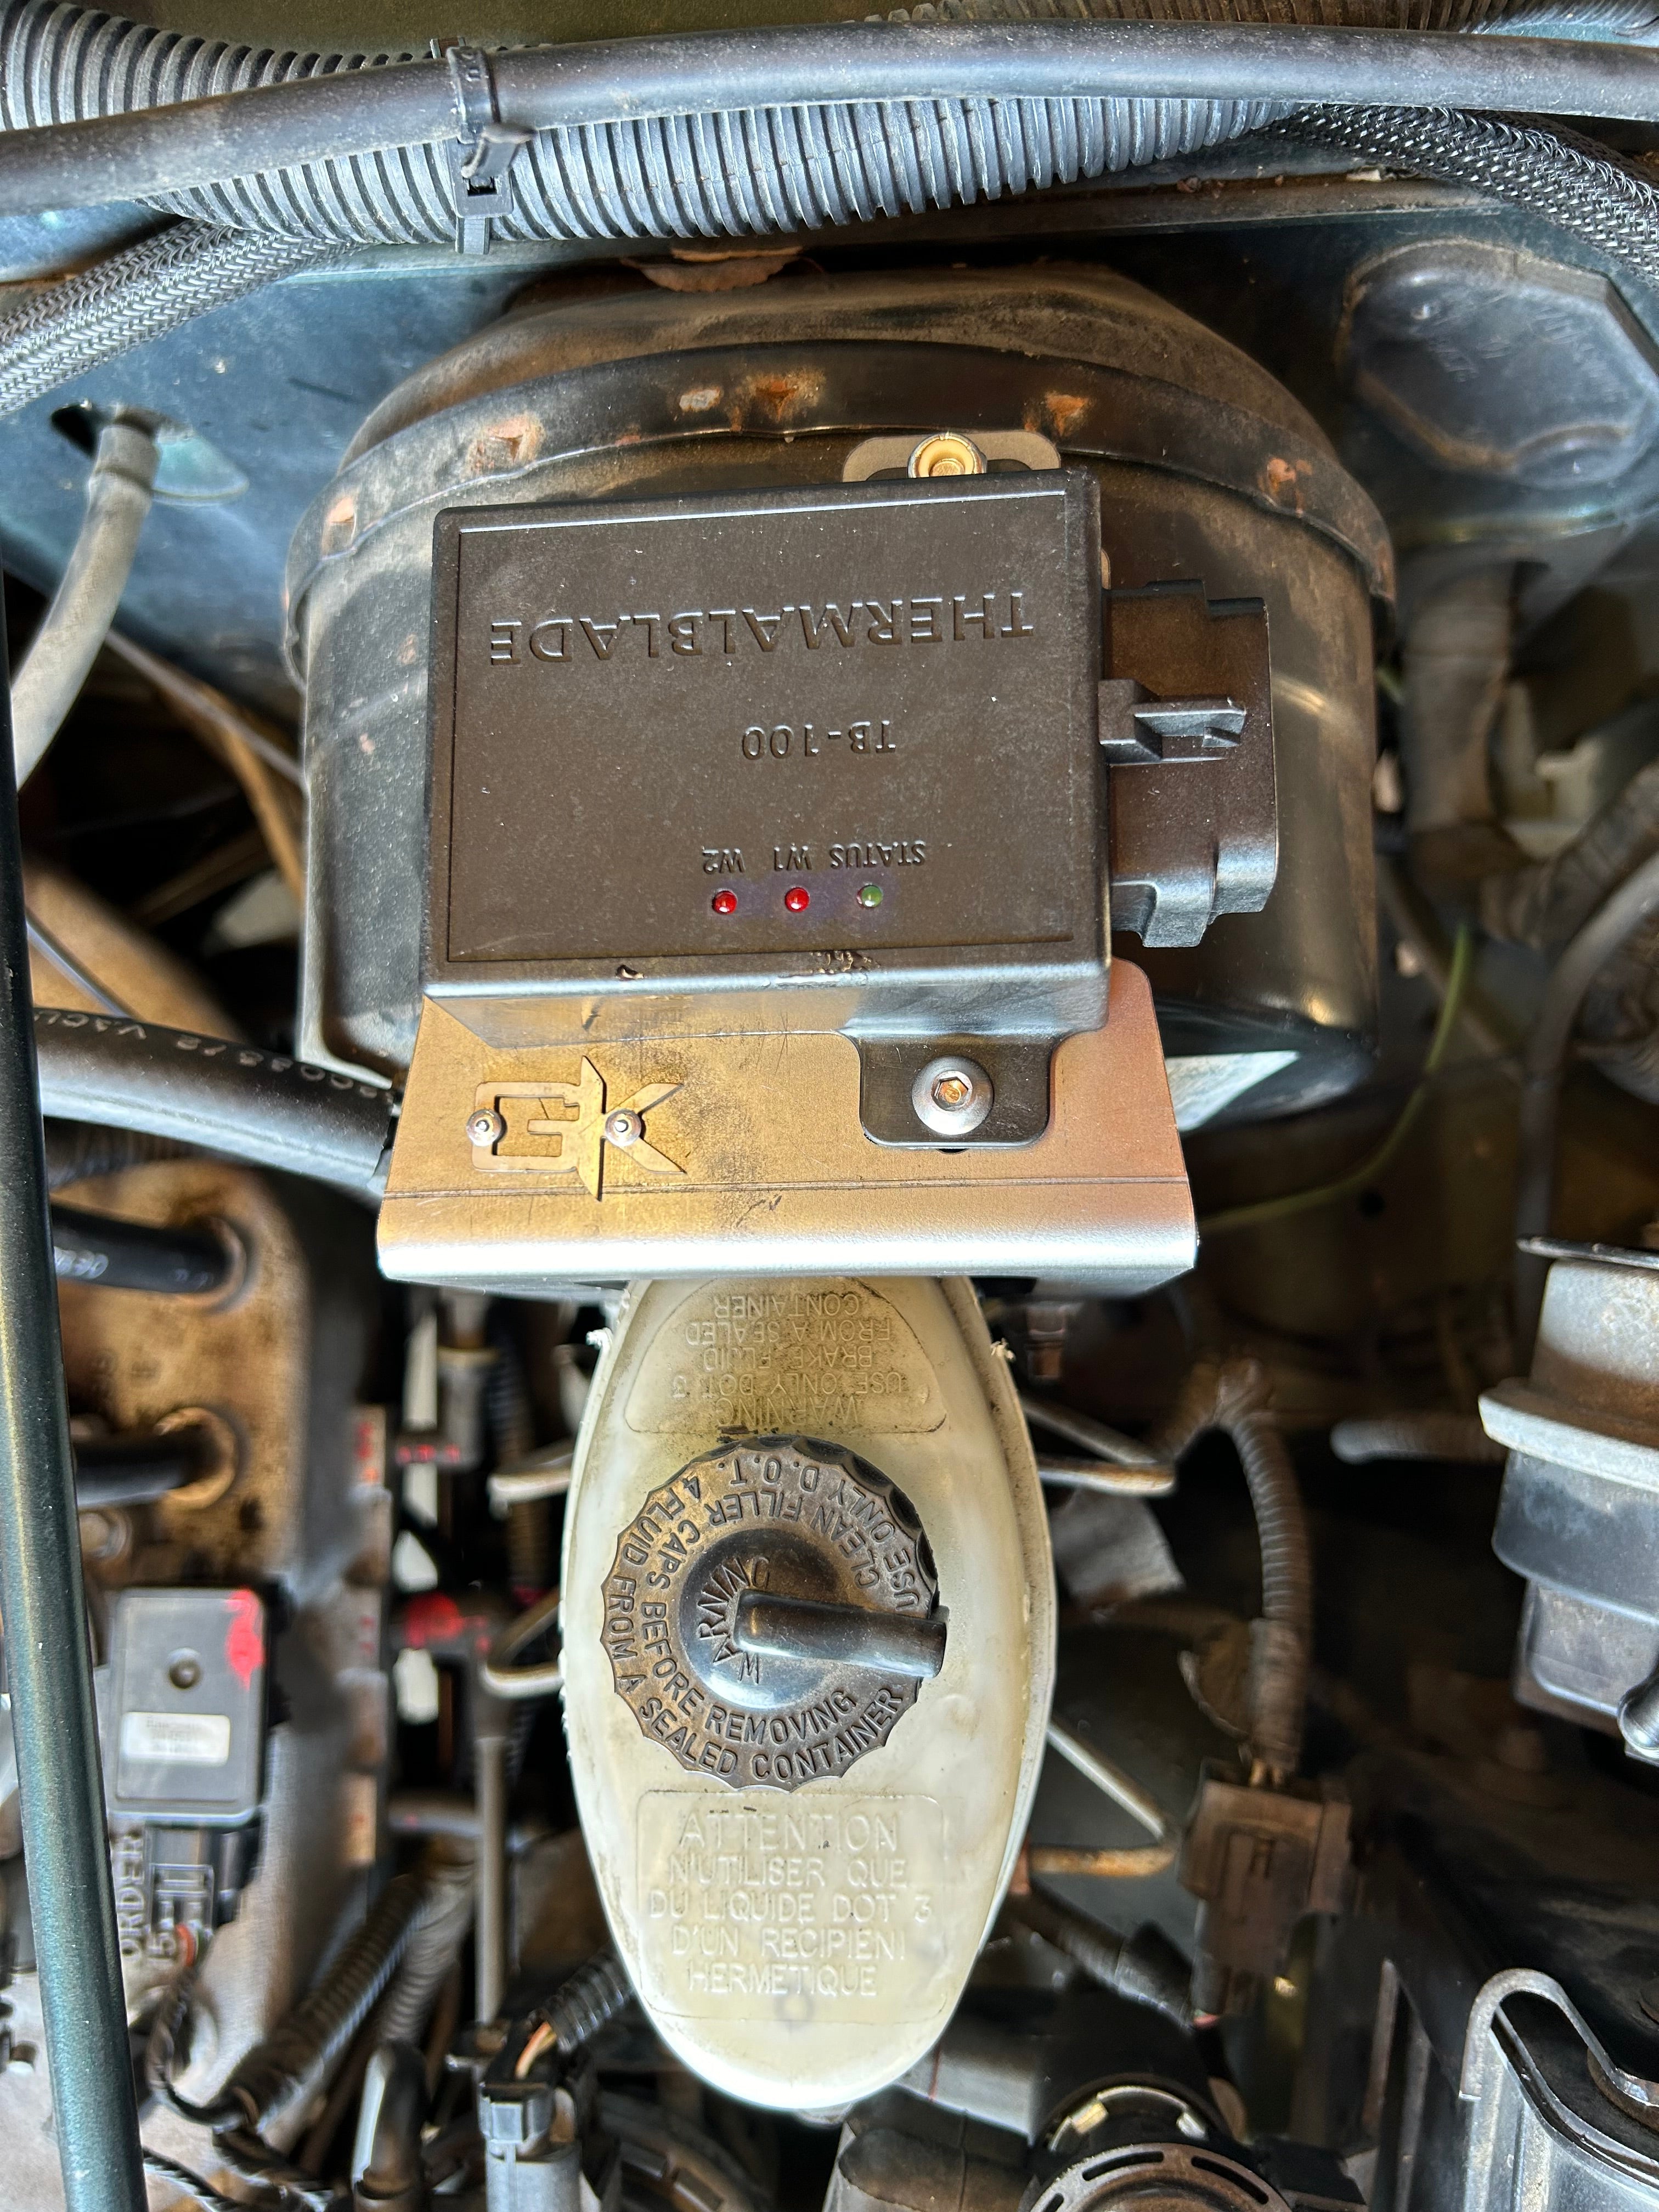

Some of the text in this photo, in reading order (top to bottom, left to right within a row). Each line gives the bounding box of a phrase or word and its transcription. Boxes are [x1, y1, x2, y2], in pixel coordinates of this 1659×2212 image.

[488, 590, 1034, 667] THERMALBLADE
[740, 719, 896, 761] TB-100
[701, 839, 927, 875] STATUS W1 W2
[715, 1294, 860, 1318] CONTAINER
[685, 1319, 891, 1346] FROM A SEALED
[703, 1345, 872, 1372] BRAKE FLUID
[672, 1372, 902, 1398] USE ONLY DOT 3
[715, 1396, 860, 1426] WARNING
[681, 1476, 702, 1500] 4
[623, 1492, 686, 1566] FLUID
[828, 1480, 897, 1543] ONLY
[884, 1548, 919, 1610] USE
[608, 1574, 639, 1661] FROM
[641, 1489, 880, 1746] CLEAN FILLER CAPS BEFORE REMOVING
[697, 1556, 770, 1684] WARNING
[617, 1673, 648, 1693] A
[640, 1697, 738, 1778] SEALED
[753, 1686, 903, 1781] CONTAINER
[680, 1812, 900, 1852] ATTENTION
[669, 1854, 907, 1888] N'UTILISER QUE
[116, 1836, 145, 1963] ORDER
[650, 1889, 933, 1924] DU LIQUIDE DOT 3
[672, 1925, 739, 1956] D'UN
[689, 1962, 877, 1997] HERMETIQUE
